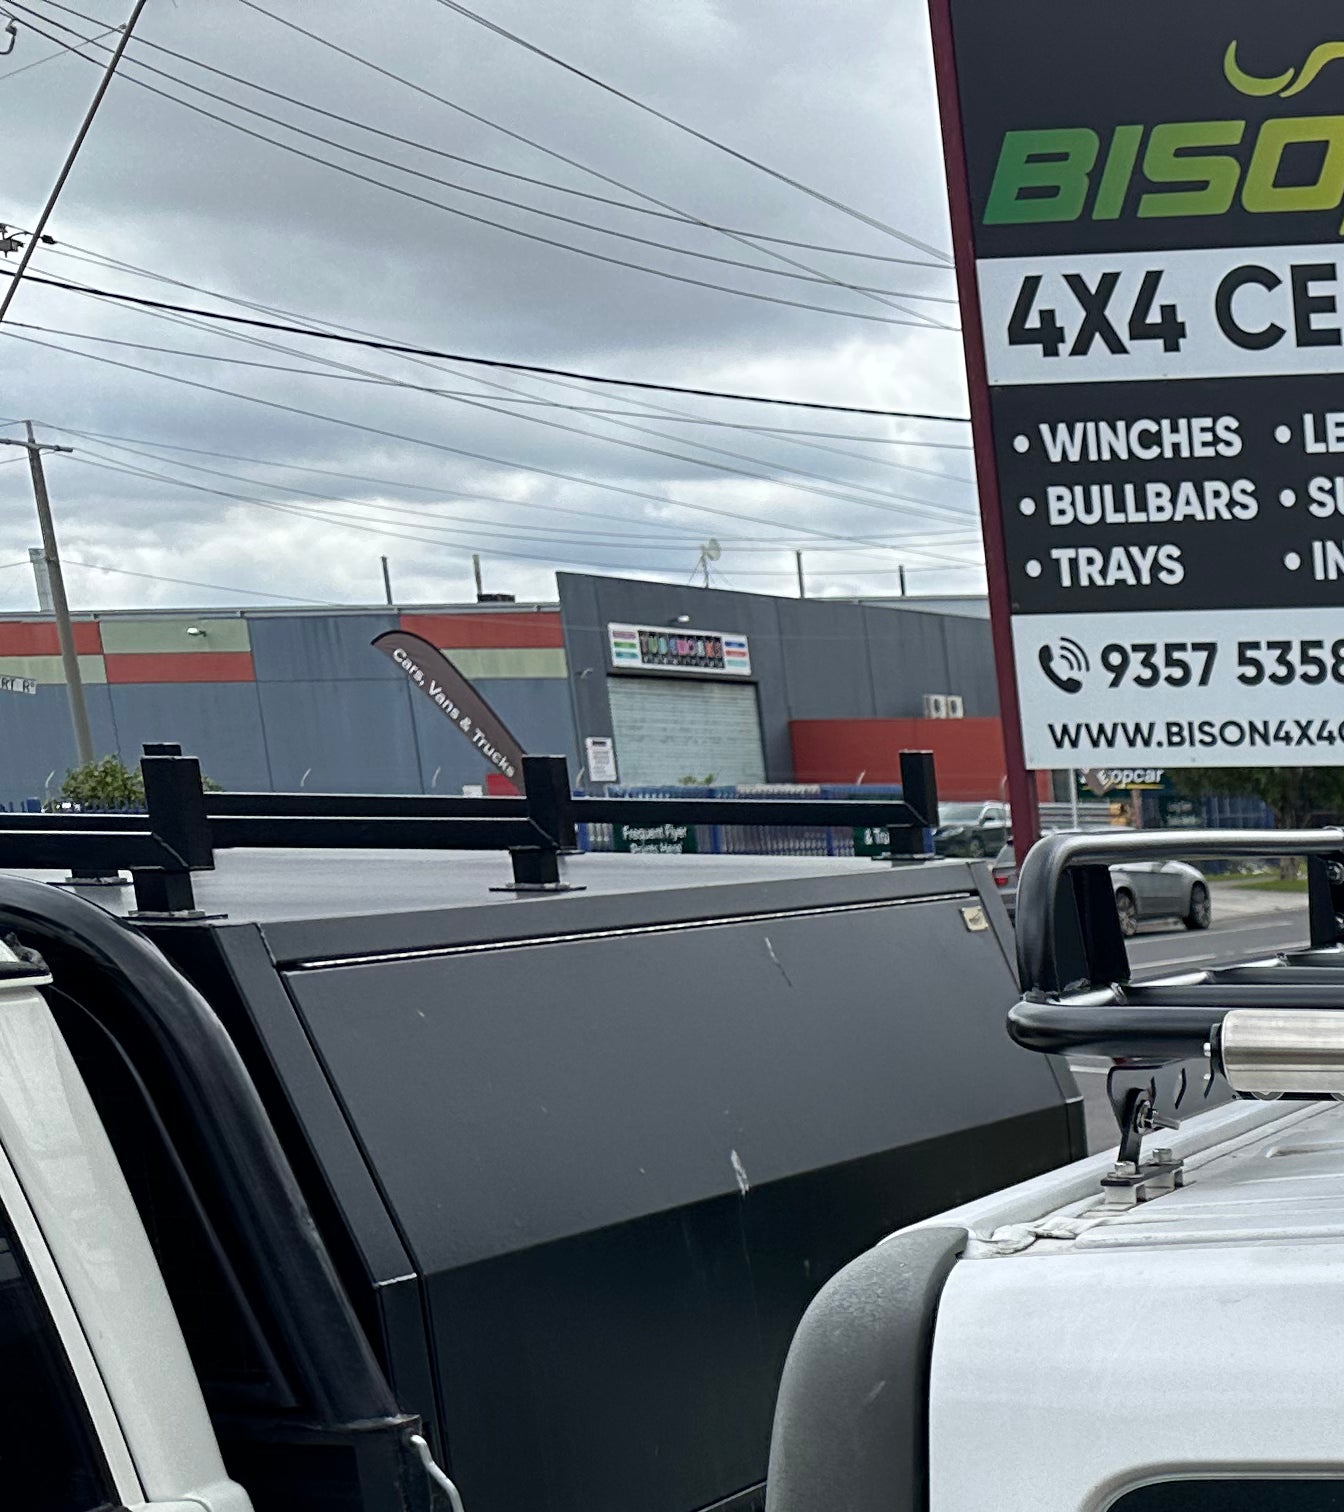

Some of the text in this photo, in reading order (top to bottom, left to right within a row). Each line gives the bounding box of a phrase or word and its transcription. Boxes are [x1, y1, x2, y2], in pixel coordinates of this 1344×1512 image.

[1008, 270, 1186, 357] 4X4
[1039, 416, 1242, 462] WINCHES
[1047, 479, 1259, 525] BULLBARS
[1051, 545, 1186, 587] TRAYS
[1100, 641, 1217, 688] 9357
[428, 679, 460, 723] Vans
[459, 716, 472, 732] &
[472, 727, 517, 778] Trucks
